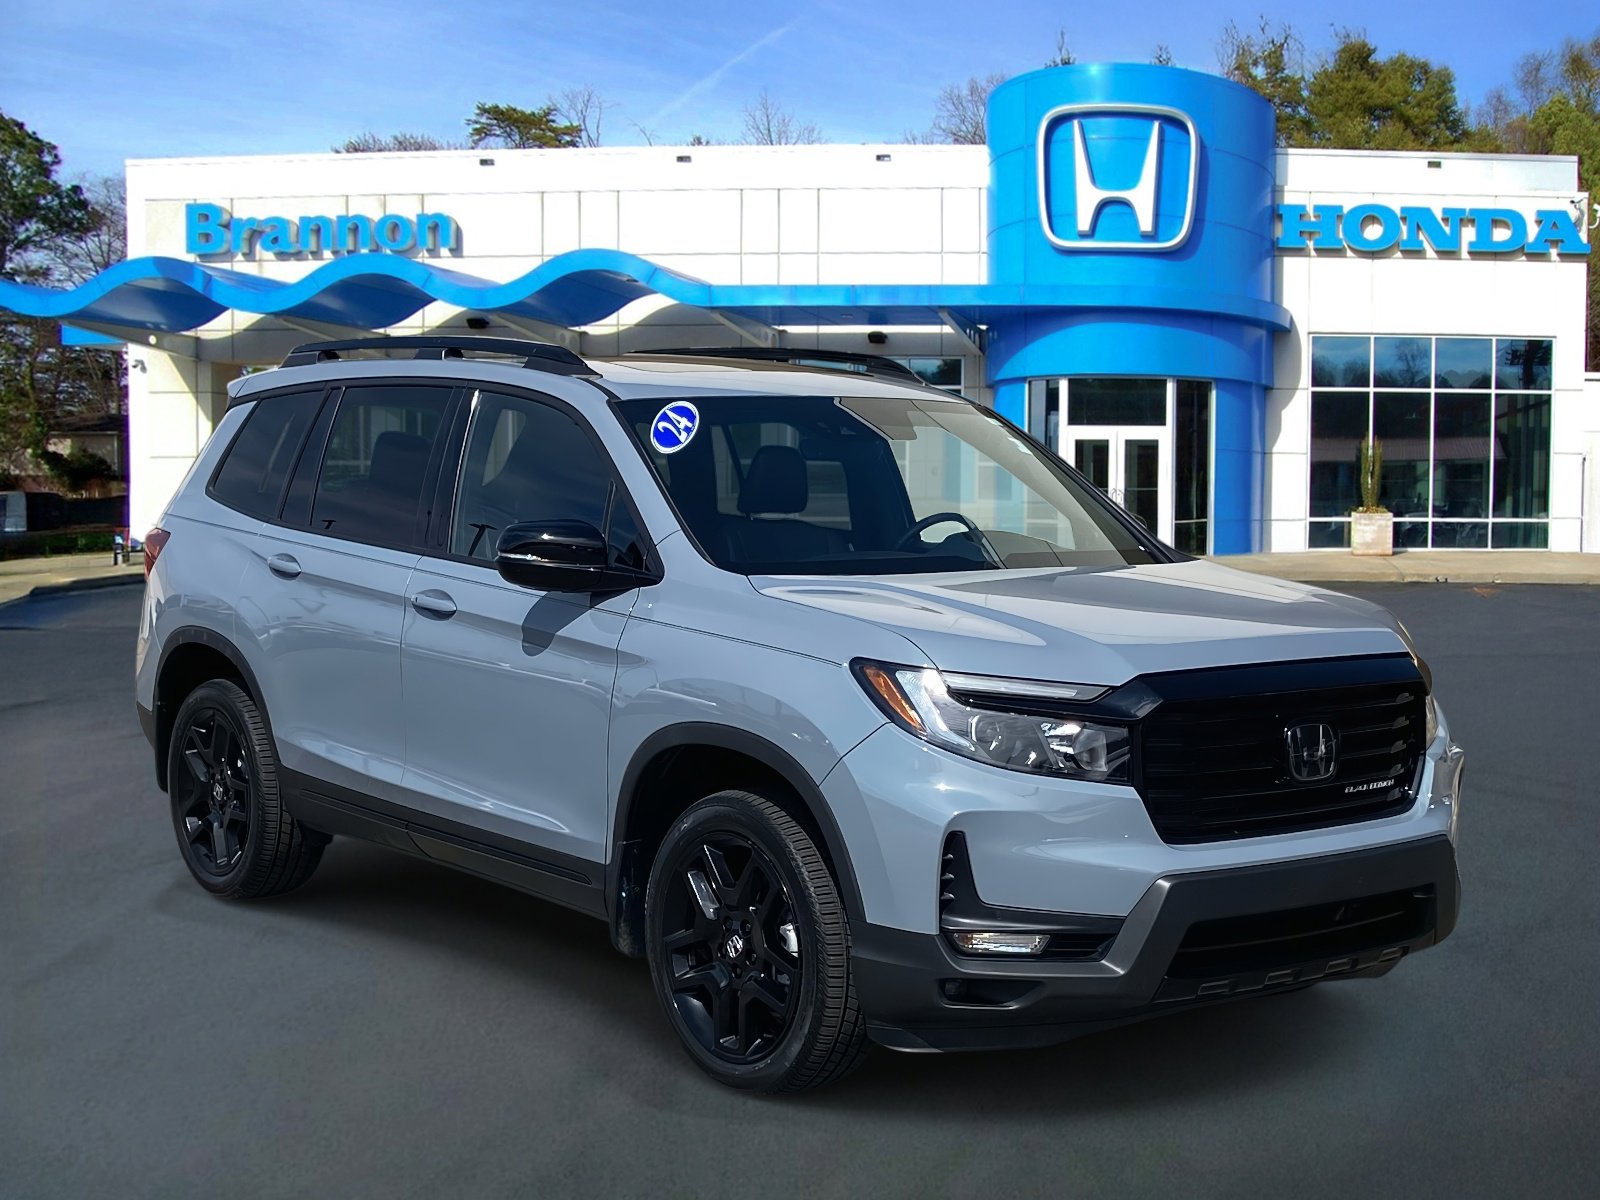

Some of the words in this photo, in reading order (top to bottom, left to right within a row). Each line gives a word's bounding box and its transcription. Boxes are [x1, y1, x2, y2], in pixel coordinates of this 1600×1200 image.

[185, 202, 455, 255] Brannon
[1276, 203, 1592, 255] HONDA
[657, 408, 694, 444] 24
